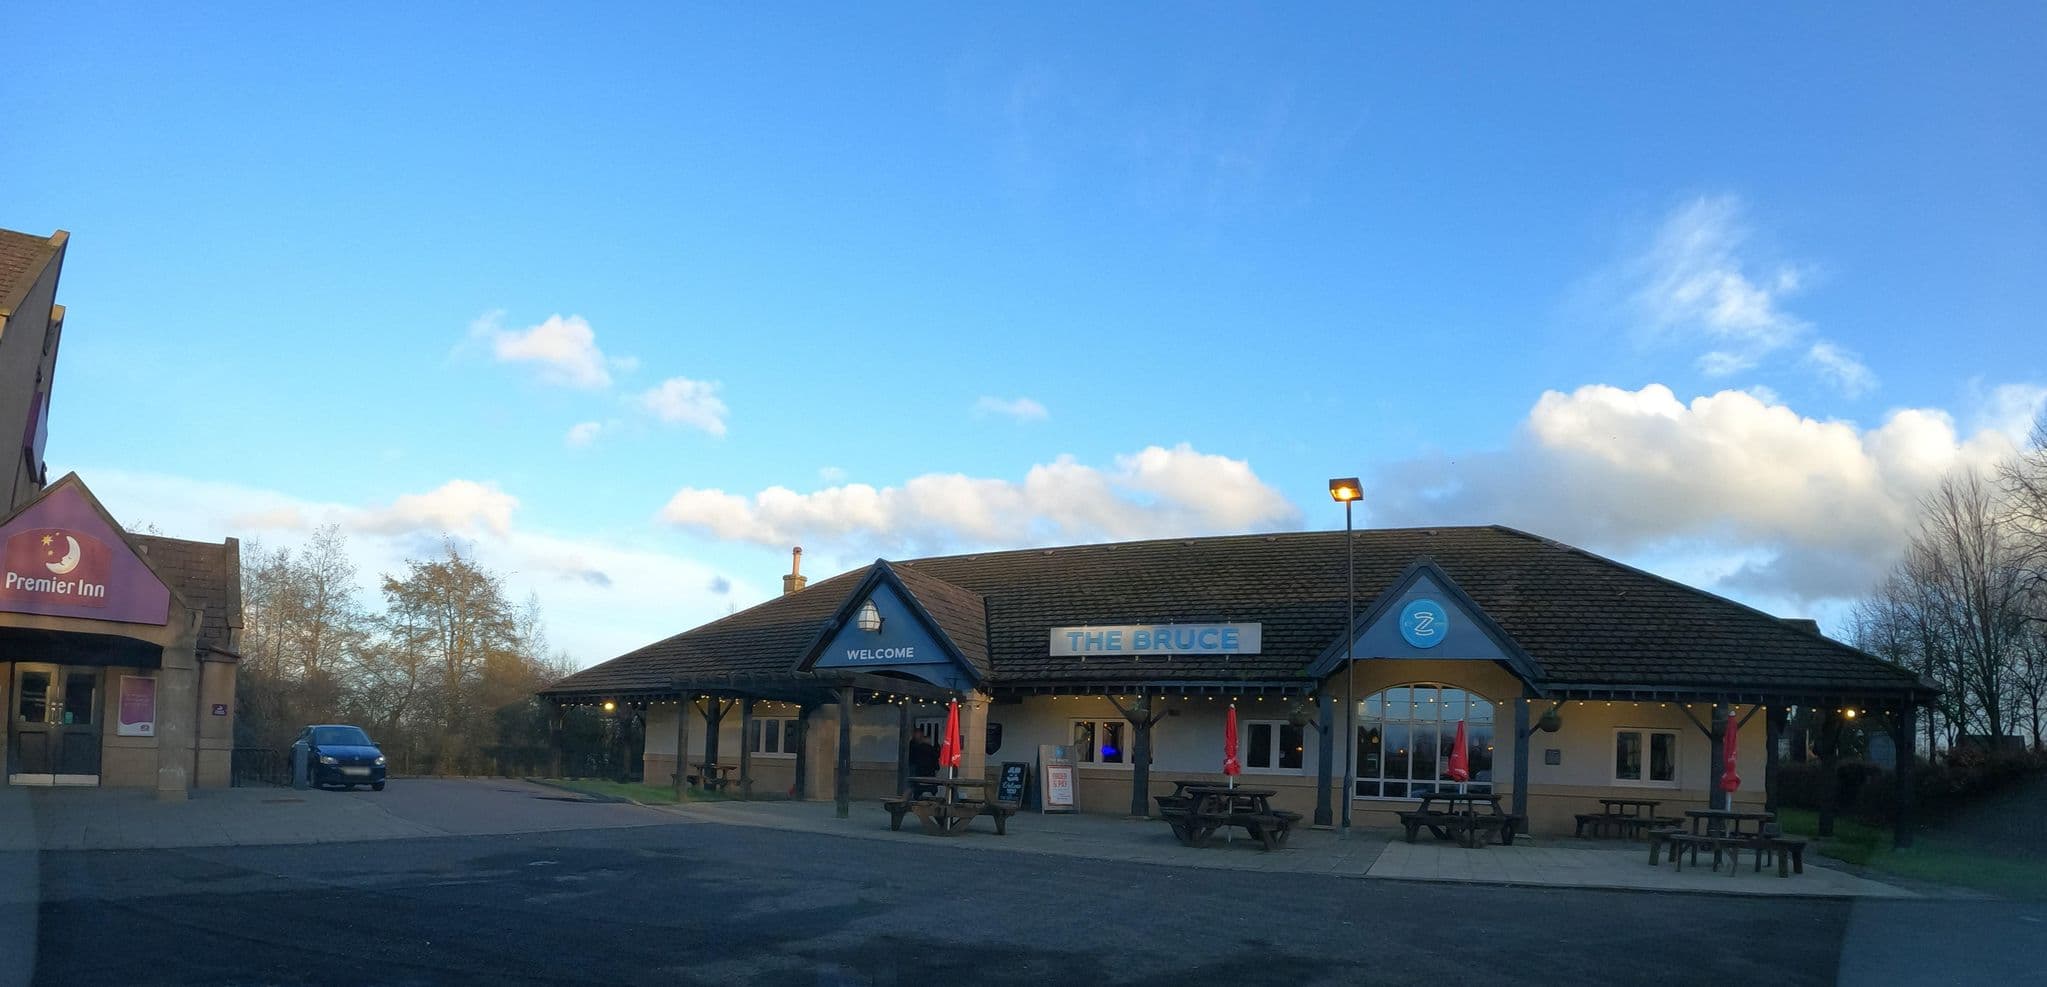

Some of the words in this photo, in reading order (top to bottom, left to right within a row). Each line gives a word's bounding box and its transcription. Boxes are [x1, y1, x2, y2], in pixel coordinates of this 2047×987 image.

[5, 572, 76, 594] Premier
[78, 579, 105, 598] Inn
[1066, 631, 1122, 651] THE
[1134, 628, 1239, 650] BRUCE
[847, 647, 914, 660] WELCOME
